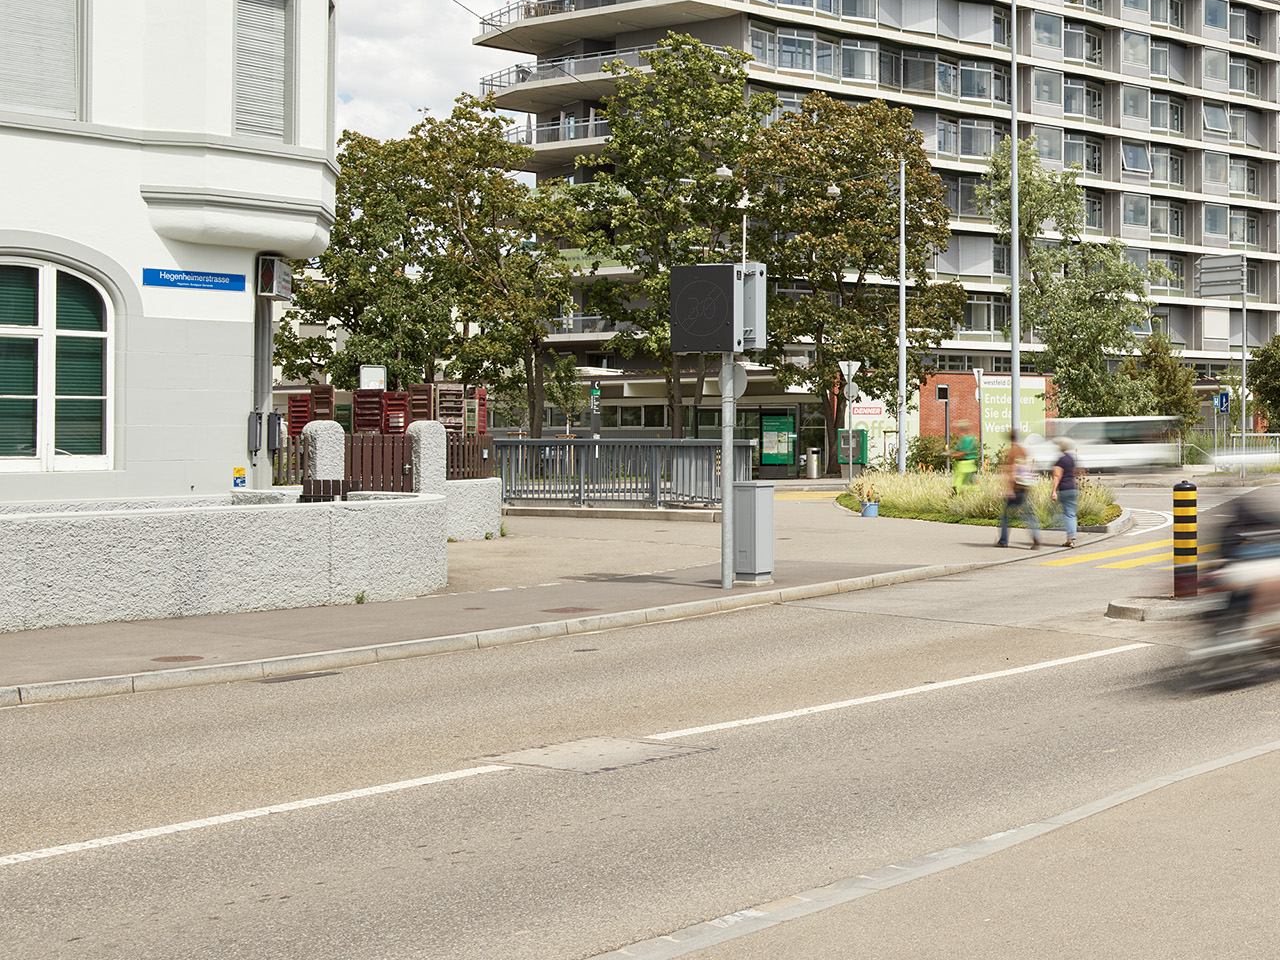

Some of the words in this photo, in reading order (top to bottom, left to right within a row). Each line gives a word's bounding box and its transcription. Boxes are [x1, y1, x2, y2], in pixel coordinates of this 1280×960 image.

[159, 271, 230, 283] Hegenheimerstrasse
[984, 393, 1035, 405] Entdeken
[853, 407, 881, 415] DENNER
[984, 407, 999, 418] Sie
[1001, 407, 1013, 418] da
[984, 421, 1032, 433] Westld.
